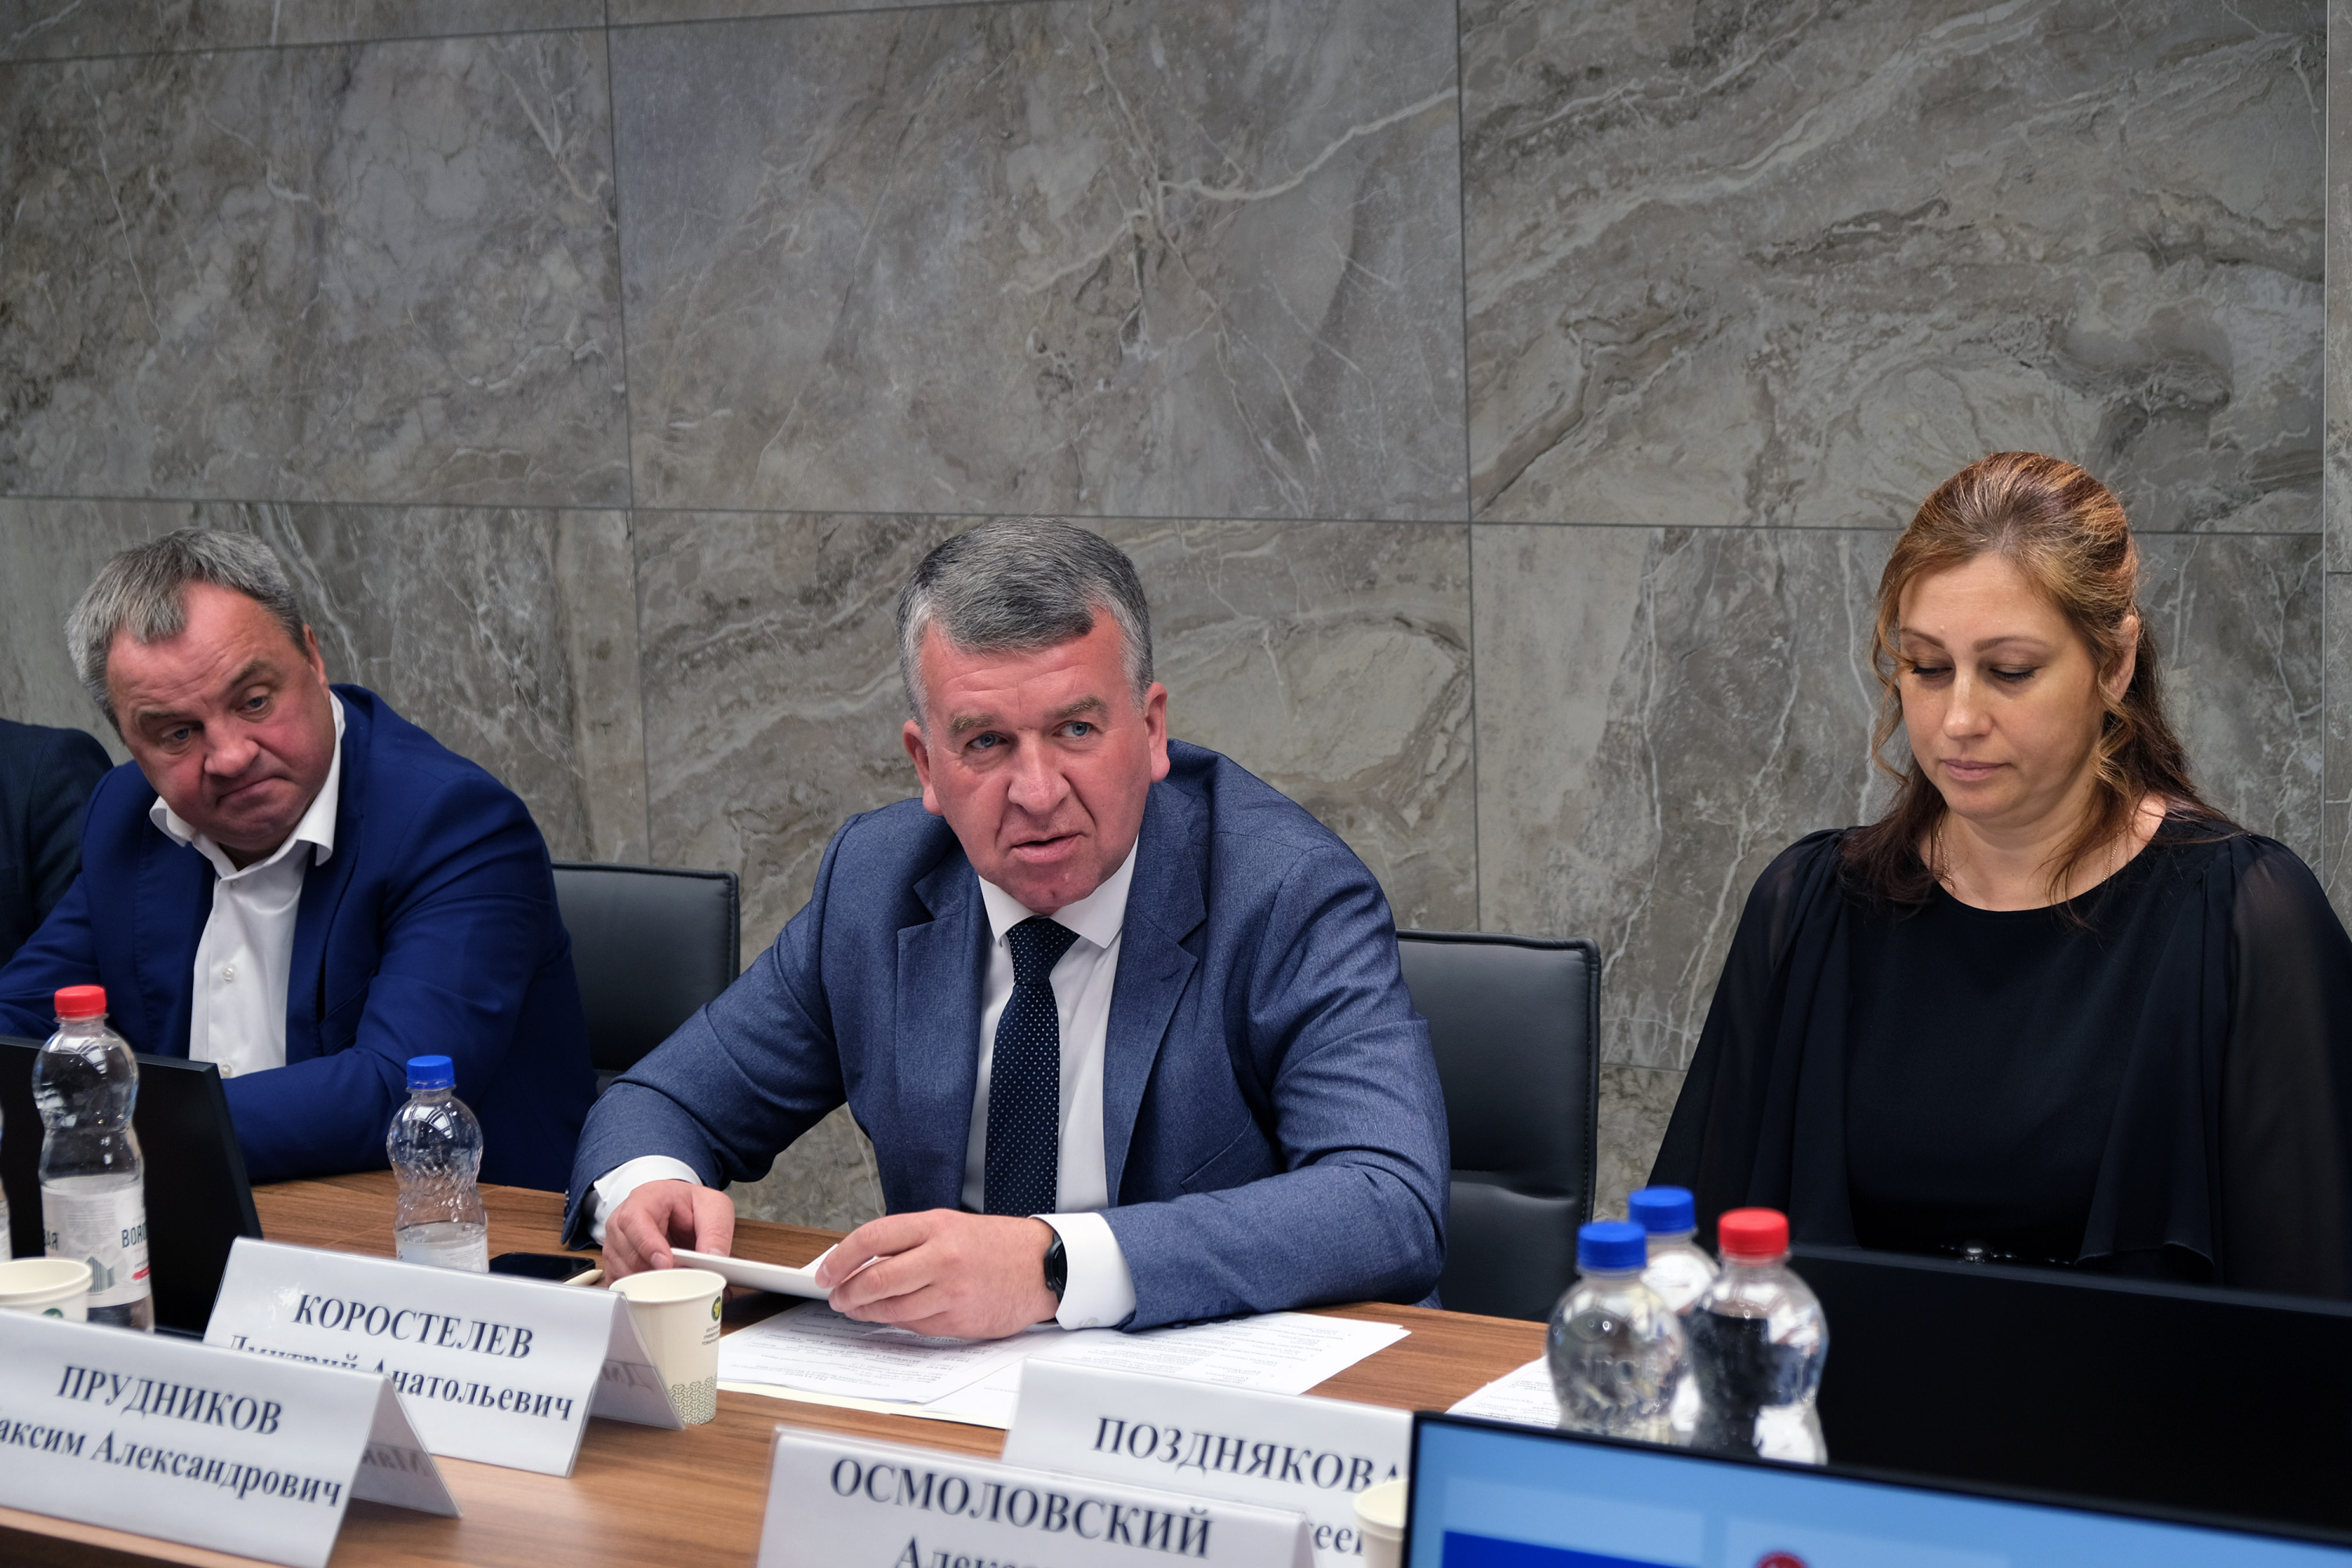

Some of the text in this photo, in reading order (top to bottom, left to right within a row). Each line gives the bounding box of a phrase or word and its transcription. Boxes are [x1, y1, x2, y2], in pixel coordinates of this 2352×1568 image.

[291, 1294, 534, 1359] КОРОСТЕЛЕВ
[55, 1365, 282, 1436] ПРУДНИКОВ
[89, 1429, 343, 1508] Александрович
[829, 1458, 1214, 1559] ОСМОЛОВСКИЙ
